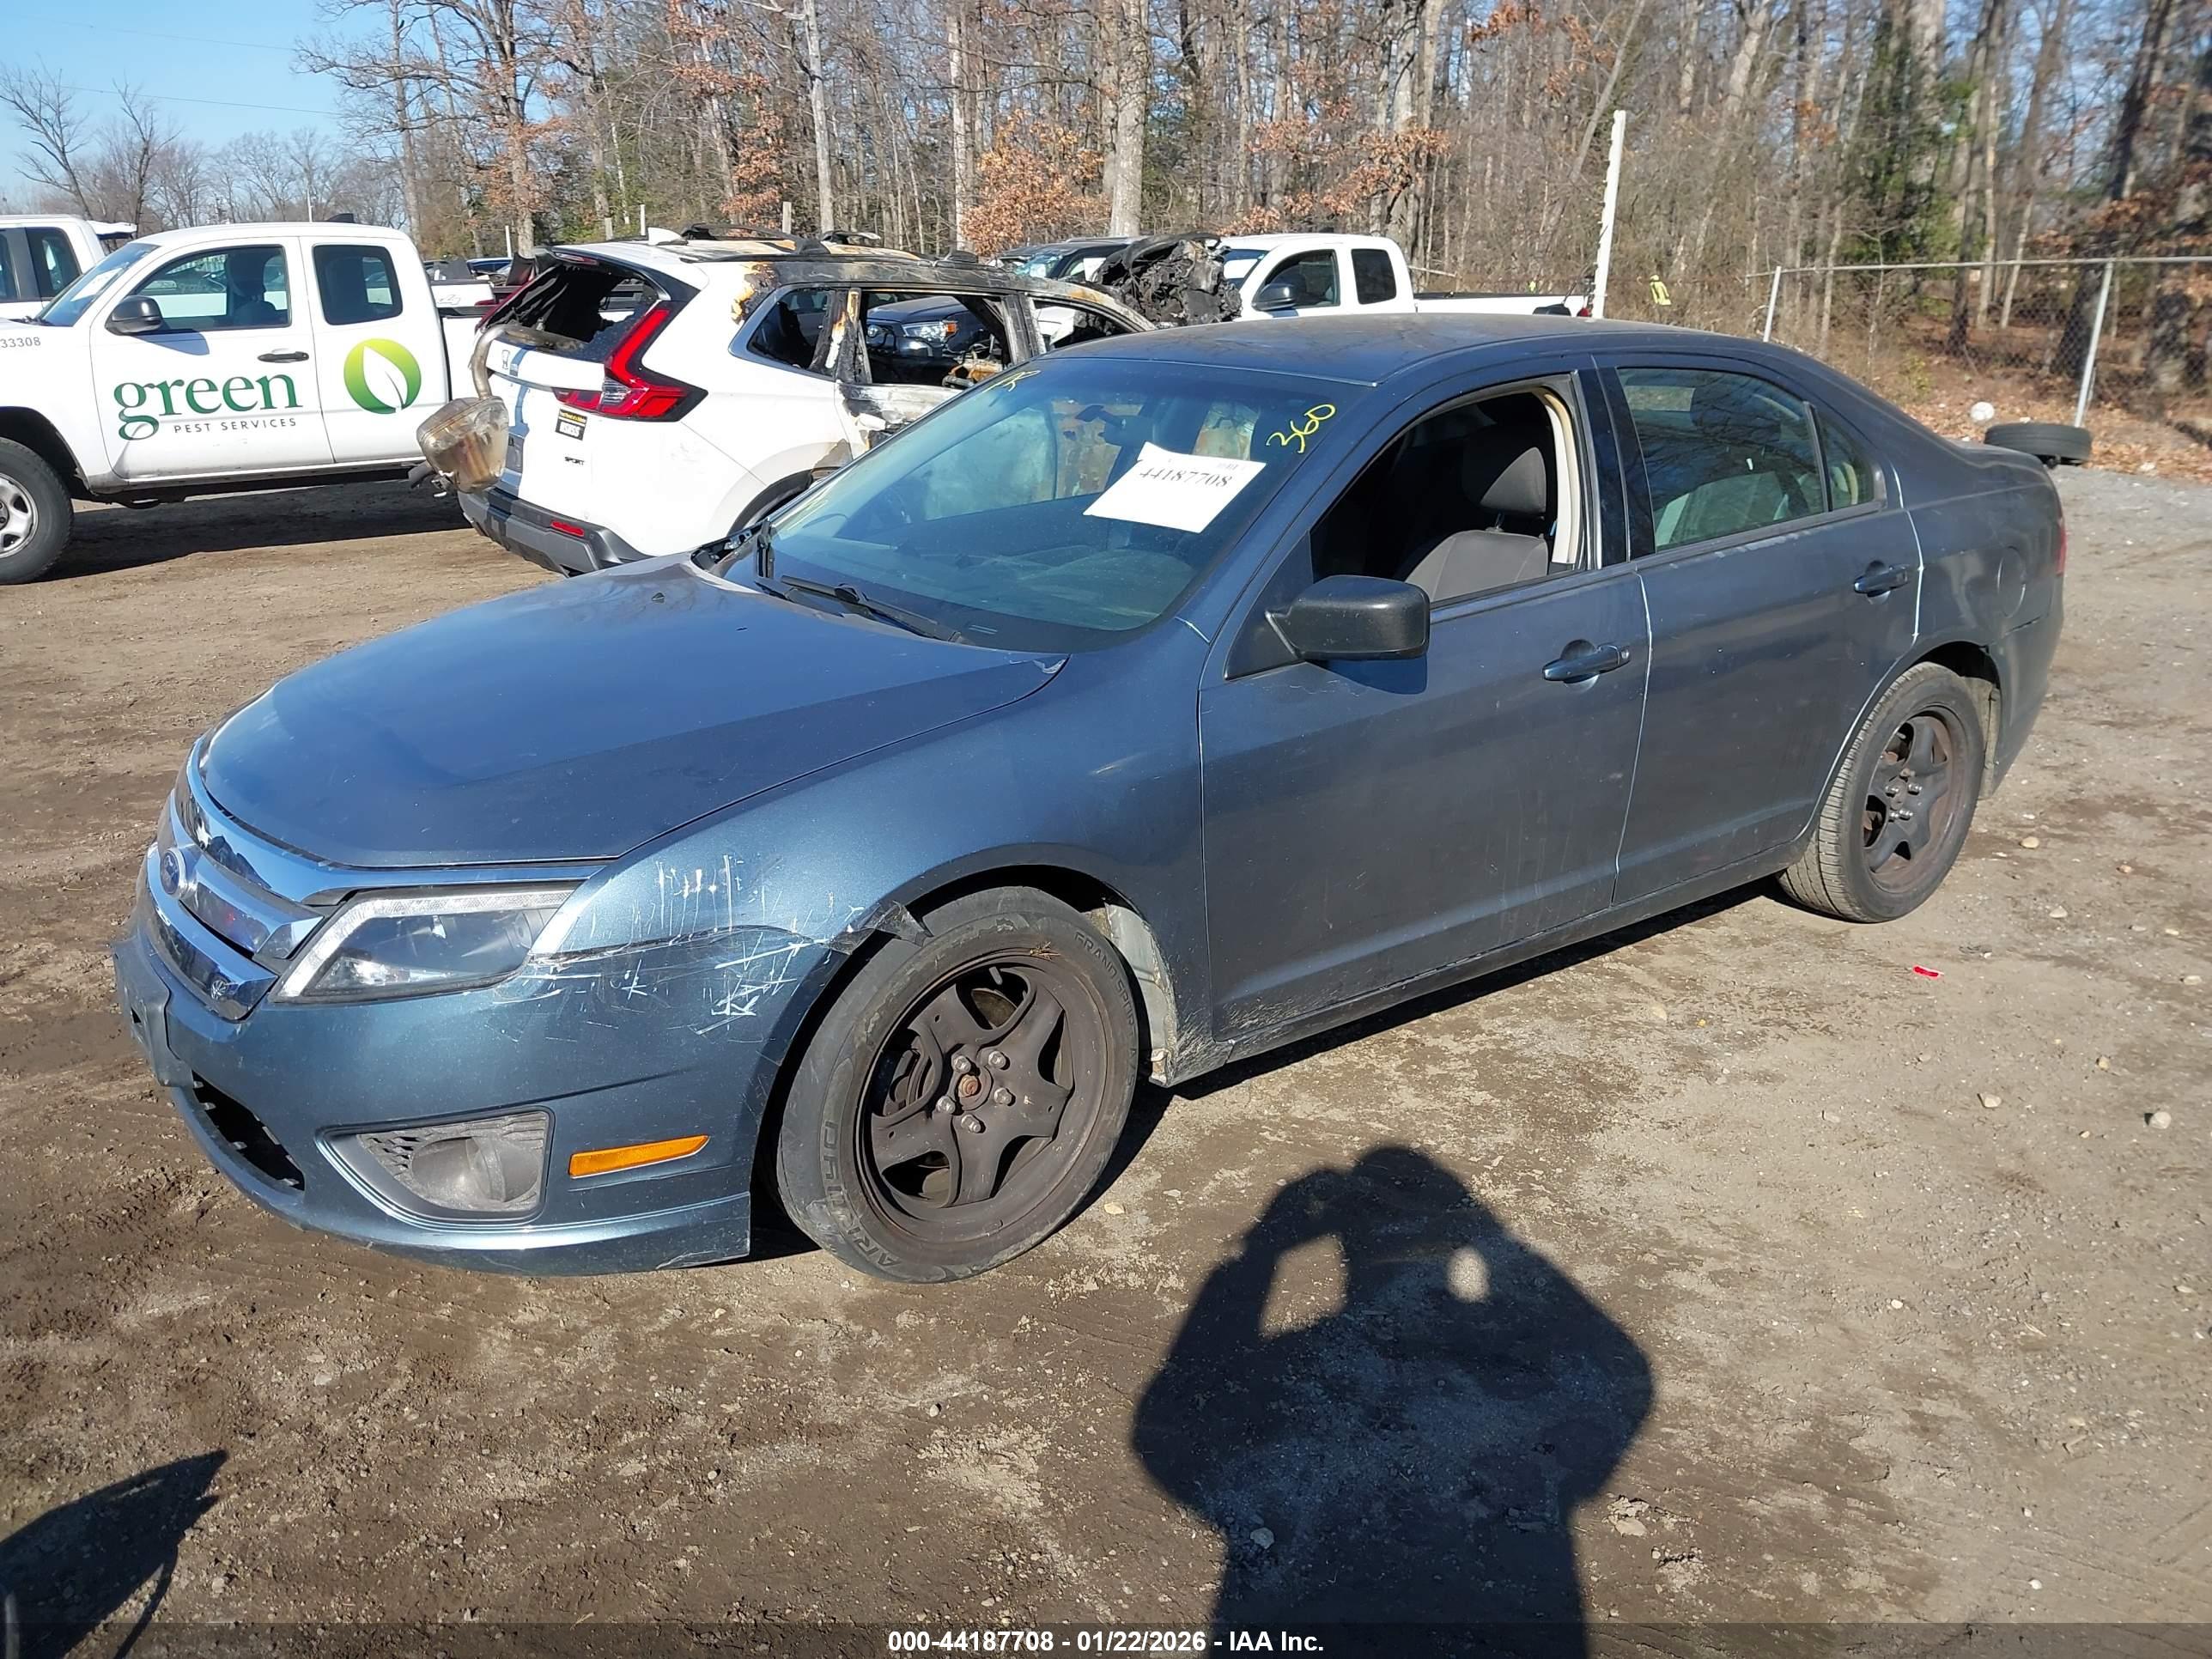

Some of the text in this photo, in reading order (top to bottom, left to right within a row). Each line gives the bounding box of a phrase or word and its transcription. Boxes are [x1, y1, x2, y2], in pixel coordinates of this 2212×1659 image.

[0, 337, 41, 349] 33308
[113, 374, 303, 441] green
[174, 418, 297, 434] PEST SERVICES
[1266, 404, 1336, 453] 360
[1139, 466, 1234, 488] 44187708
[1073, 931, 1117, 980] GRAND
[1115, 979, 1138, 1037] SPORT
